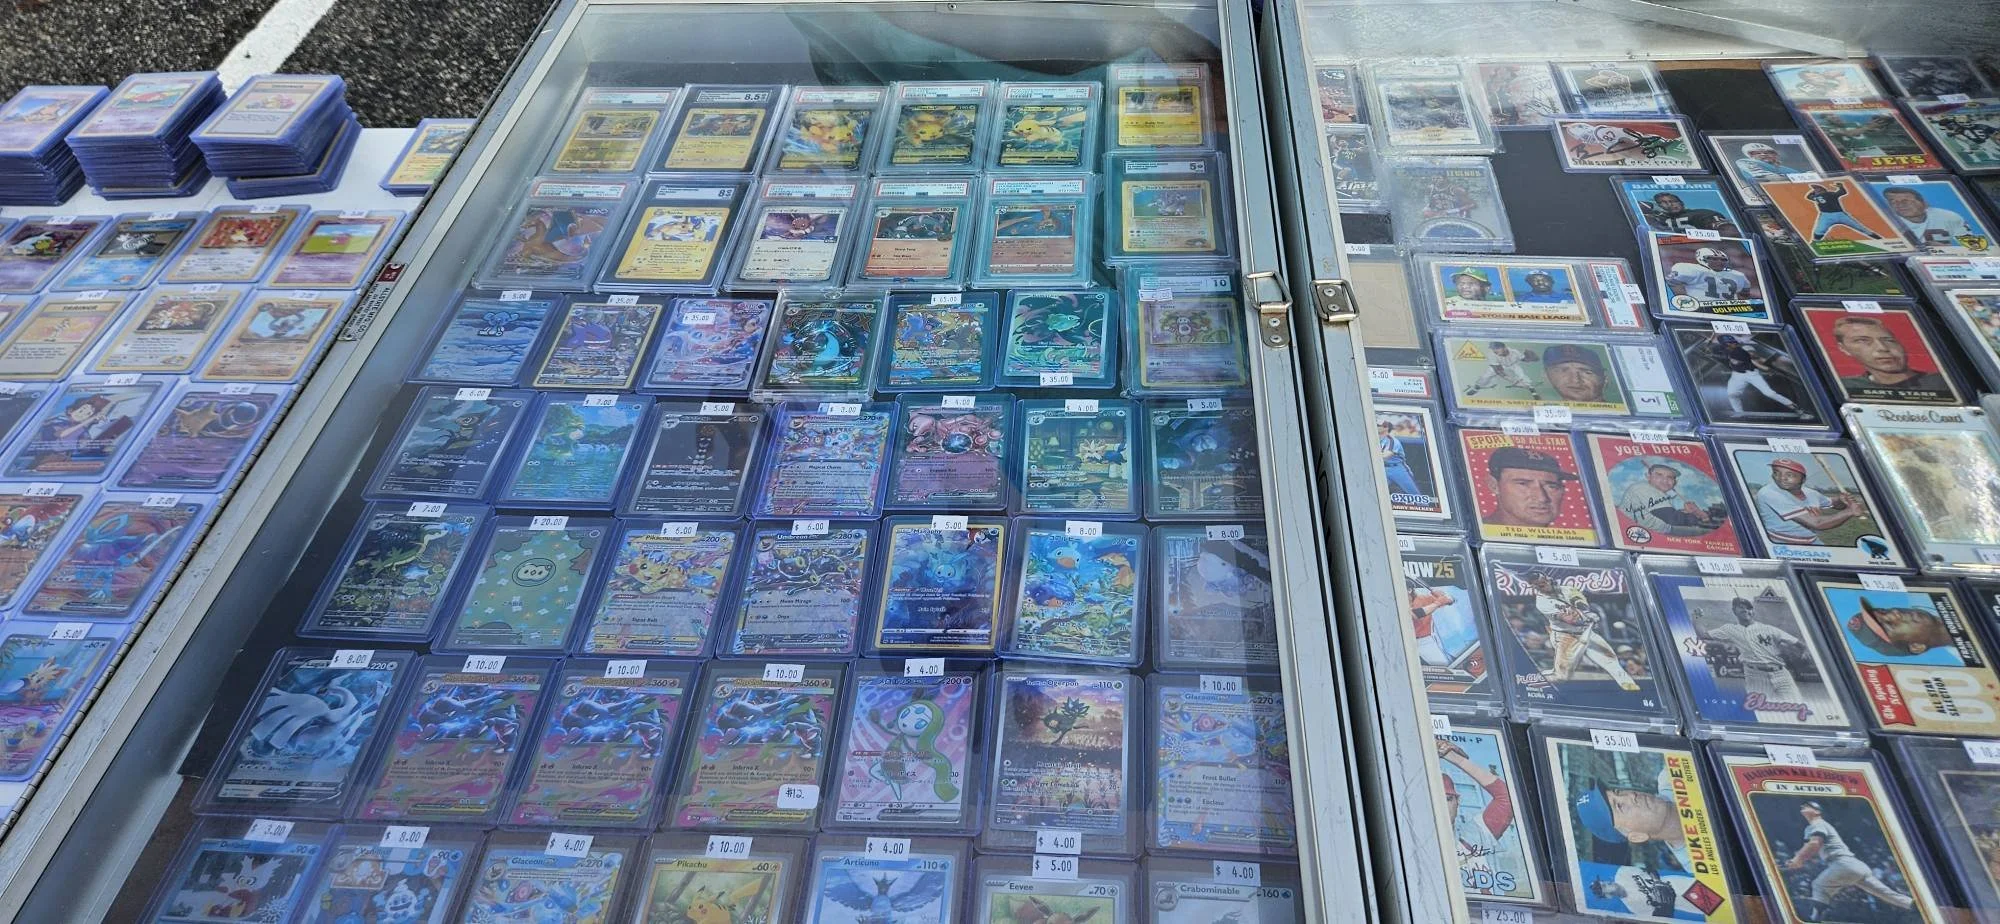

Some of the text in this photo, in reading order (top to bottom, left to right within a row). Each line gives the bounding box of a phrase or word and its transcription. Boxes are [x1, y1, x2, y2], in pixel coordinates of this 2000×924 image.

[1871, 154, 1926, 167] JETS
[1214, 279, 1227, 288] 10
[1703, 276, 1738, 301] 13
[1712, 305, 1753, 315] DOLPHINS
[1372, 370, 1389, 379] 5.00
[1200, 400, 1218, 409] 5.00
[1877, 408, 1965, 424] Rookie Card
[1614, 442, 1691, 456] yogi berra
[1391, 493, 1430, 505] expos
[540, 517, 563, 526] 20.00
[944, 521, 962, 530] 5.00
[1221, 530, 1239, 539] 8.00
[1527, 527, 1578, 535] WILLIAMS
[1552, 552, 1572, 562] 5.00
[347, 654, 368, 665] 8.00
[475, 660, 499, 670] 10.00
[371, 662, 387, 671] 220
[617, 665, 640, 675] 10.00
[919, 665, 939, 675] 4.00
[774, 669, 798, 679] 10.00
[1212, 680, 1237, 691] 10.00
[1604, 734, 1632, 748] 35.00
[1775, 782, 1833, 793] IN ACTION
[1667, 756, 1710, 876] DUKE SNIDER
[399, 830, 422, 843] 8.00
[563, 838, 586, 852] 4.00
[719, 840, 745, 854] 10.00
[882, 841, 904, 855] 4.00
[1037, 836, 1075, 849] $ 4.00
[676, 859, 770, 872] Pikachu 60
[923, 860, 938, 871] 110
[1034, 859, 1072, 872] $ 5.00
[1215, 864, 1255, 879] $ 4.00
[1009, 882, 1107, 896] Eevee 70
[1179, 884, 1280, 899] Crabominable 160
[1496, 909, 1527, 924] 25.00
